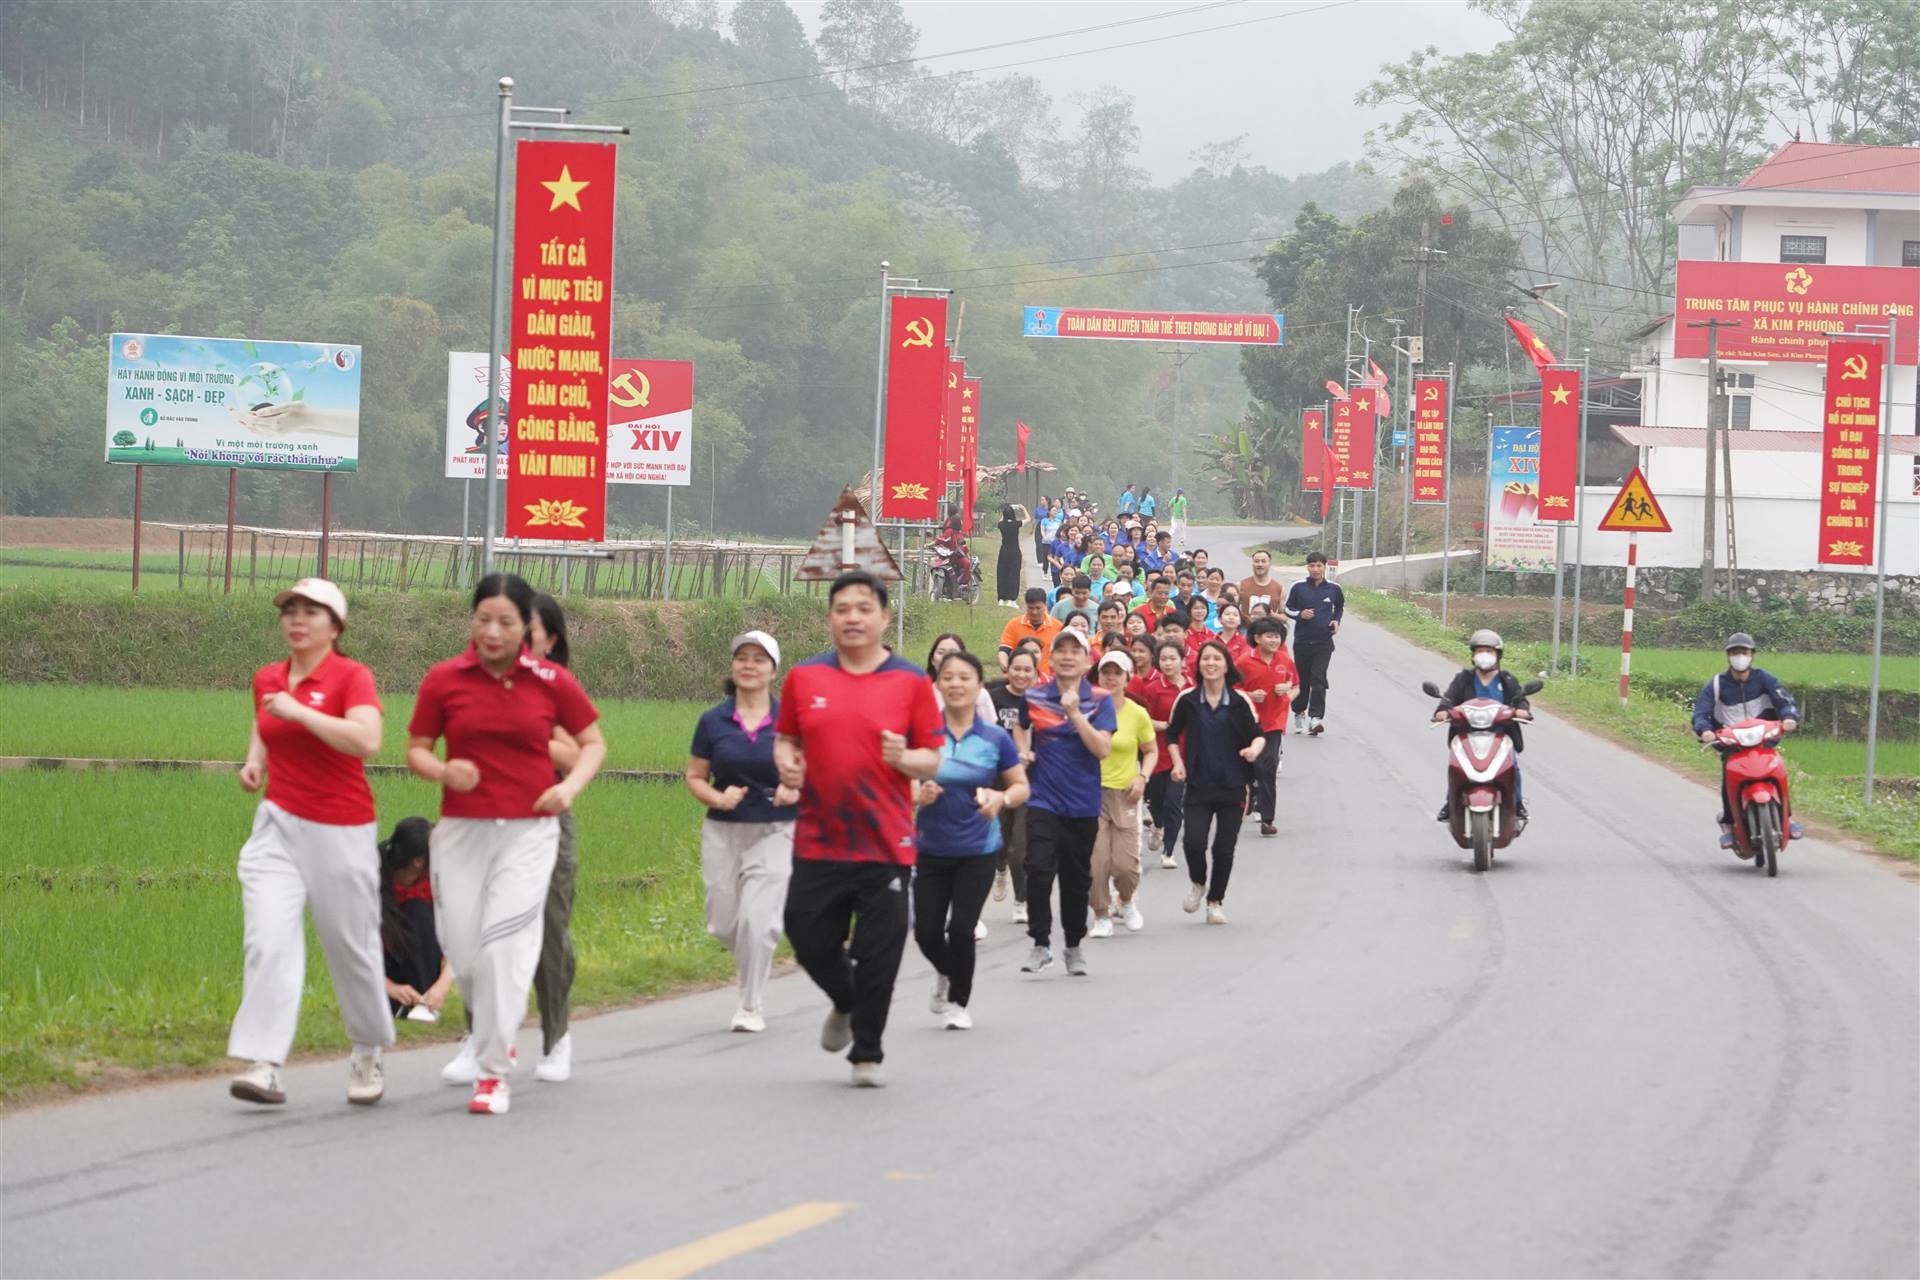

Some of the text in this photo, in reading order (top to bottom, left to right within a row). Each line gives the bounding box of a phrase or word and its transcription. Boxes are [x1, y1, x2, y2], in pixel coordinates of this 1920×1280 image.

[540, 236, 587, 266] TẤT CẢ
[522, 273, 603, 306] VÌ MỤC TIÊU
[1684, 298, 1723, 311] TRUNG
[1726, 298, 1749, 312] TÂM
[1754, 300, 1784, 315] PHỤC
[1788, 301, 1803, 315] VỤ
[1807, 300, 1838, 314] HÀNH
[1842, 302, 1878, 315] CHÍNH
[527, 309, 596, 340] DÂN GIÀU,
[1175, 321, 1192, 334] THEO
[1753, 317, 1767, 330] XÃ
[1771, 319, 1793, 331] KIM
[1751, 336, 1775, 344] Hành
[517, 344, 603, 376] NƯỚC MẠNH,
[125, 386, 154, 400] XANH
[165, 388, 194, 405] SẠCH
[204, 390, 225, 407] ĐẸP
[527, 378, 591, 410] DÂN CHỦ,
[517, 411, 599, 445] CÔNG BẰNG,
[227, 440, 244, 449] một
[296, 442, 319, 451] xanh
[631, 429, 681, 451] XIV
[212, 450, 245, 463] không
[519, 449, 596, 478] VĂN MINH !
